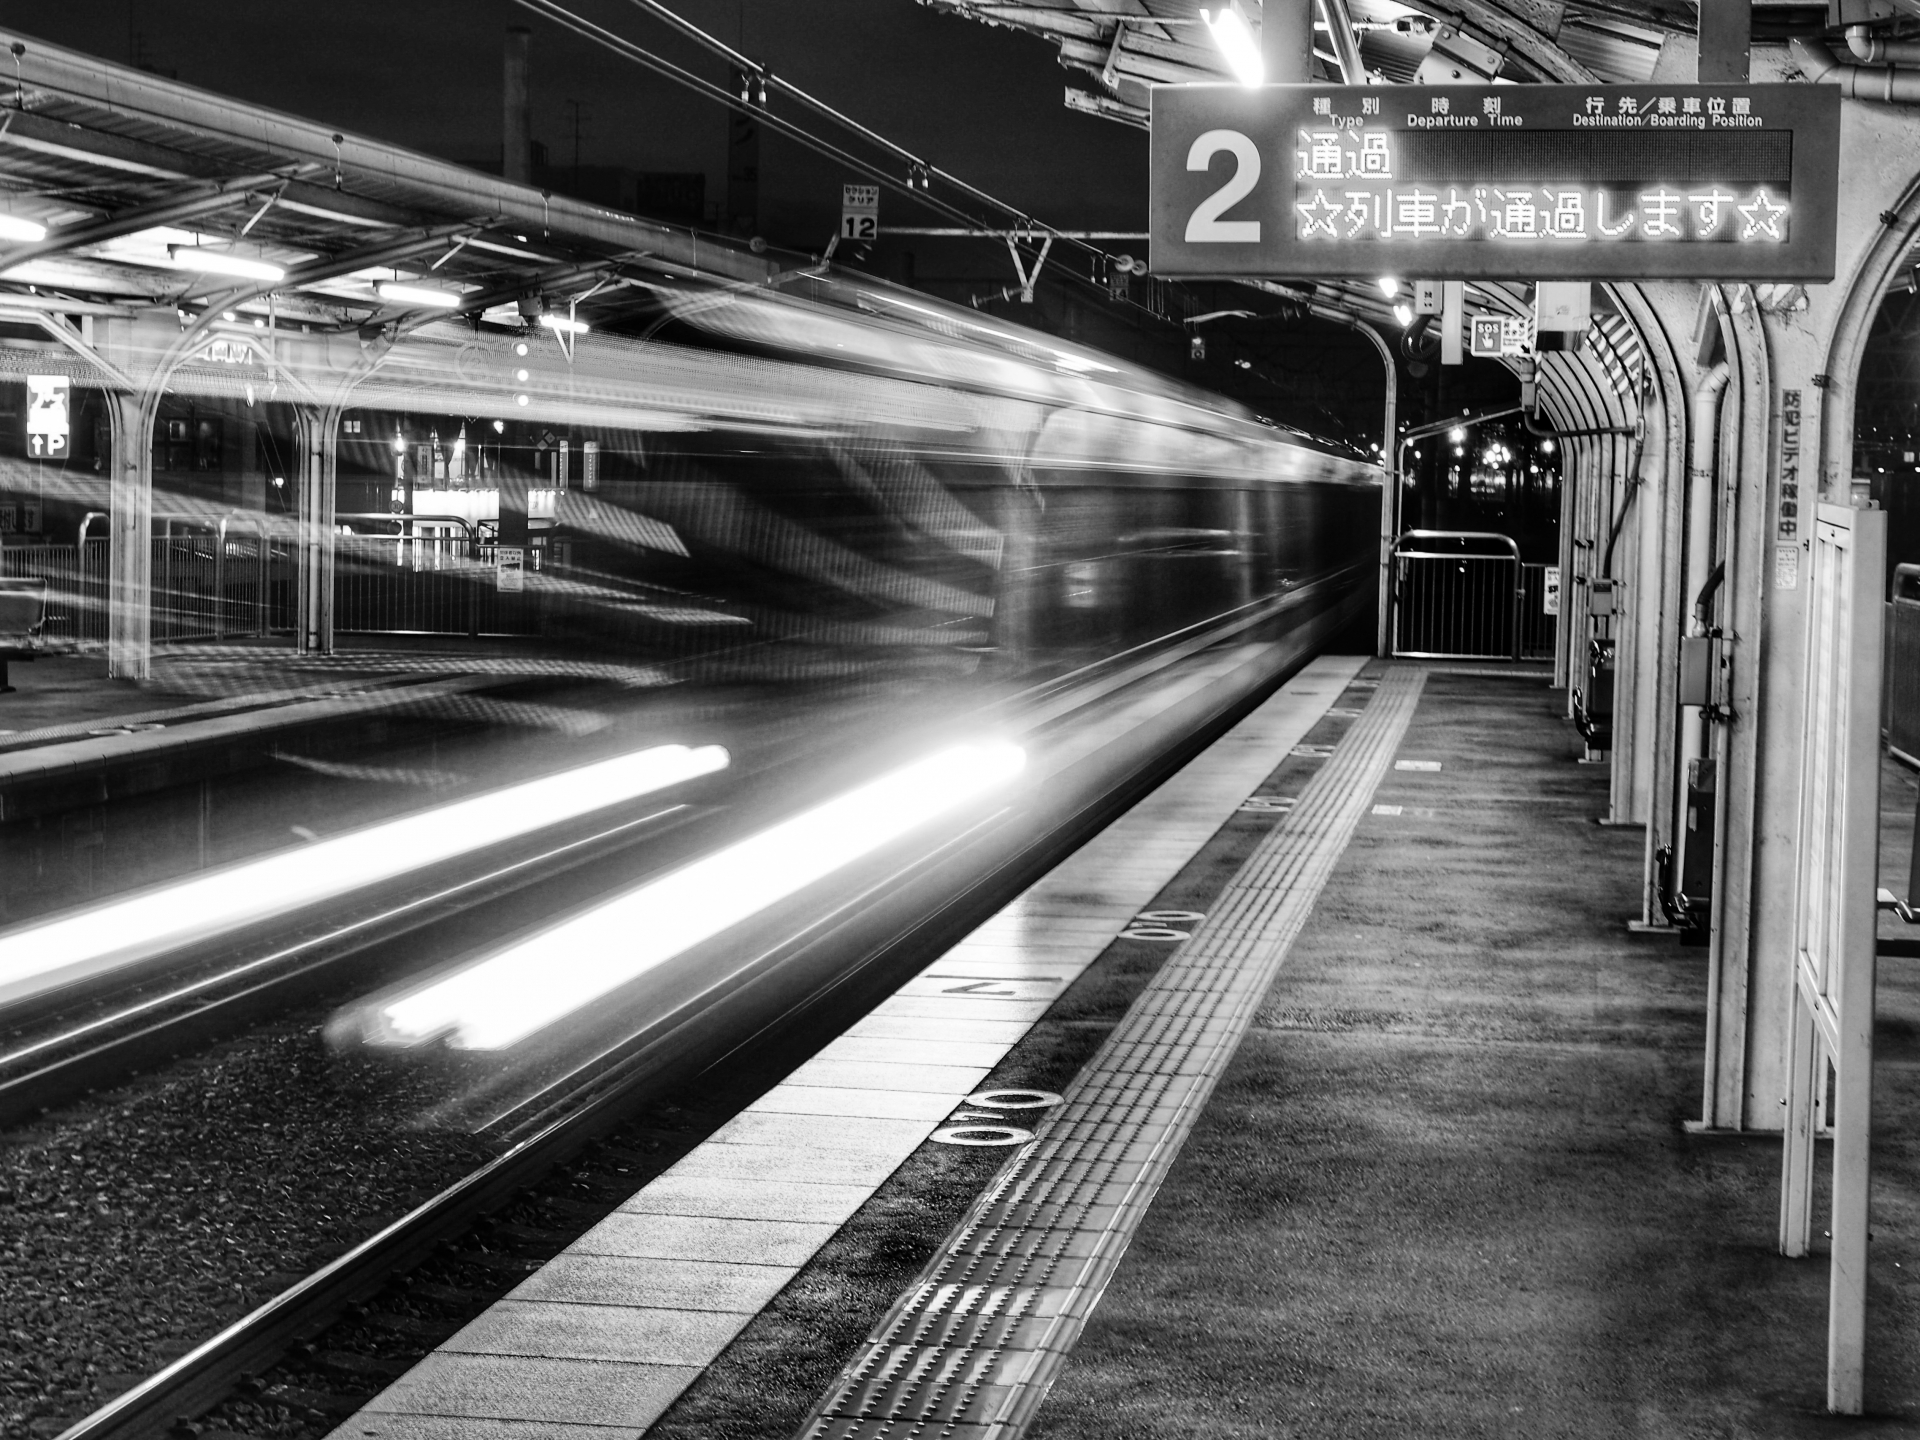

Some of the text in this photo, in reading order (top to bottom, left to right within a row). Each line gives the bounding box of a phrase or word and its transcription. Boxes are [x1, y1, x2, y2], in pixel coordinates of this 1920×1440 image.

[1329, 114, 1364, 129] Type
[1407, 113, 1522, 129] Departure Time
[1712, 113, 1763, 127] Position
[1297, 130, 1392, 179] 通過
[1185, 129, 1261, 243] 2
[846, 217, 875, 238] 12
[1478, 323, 1499, 333] SOS
[48, 434, 65, 455] P
